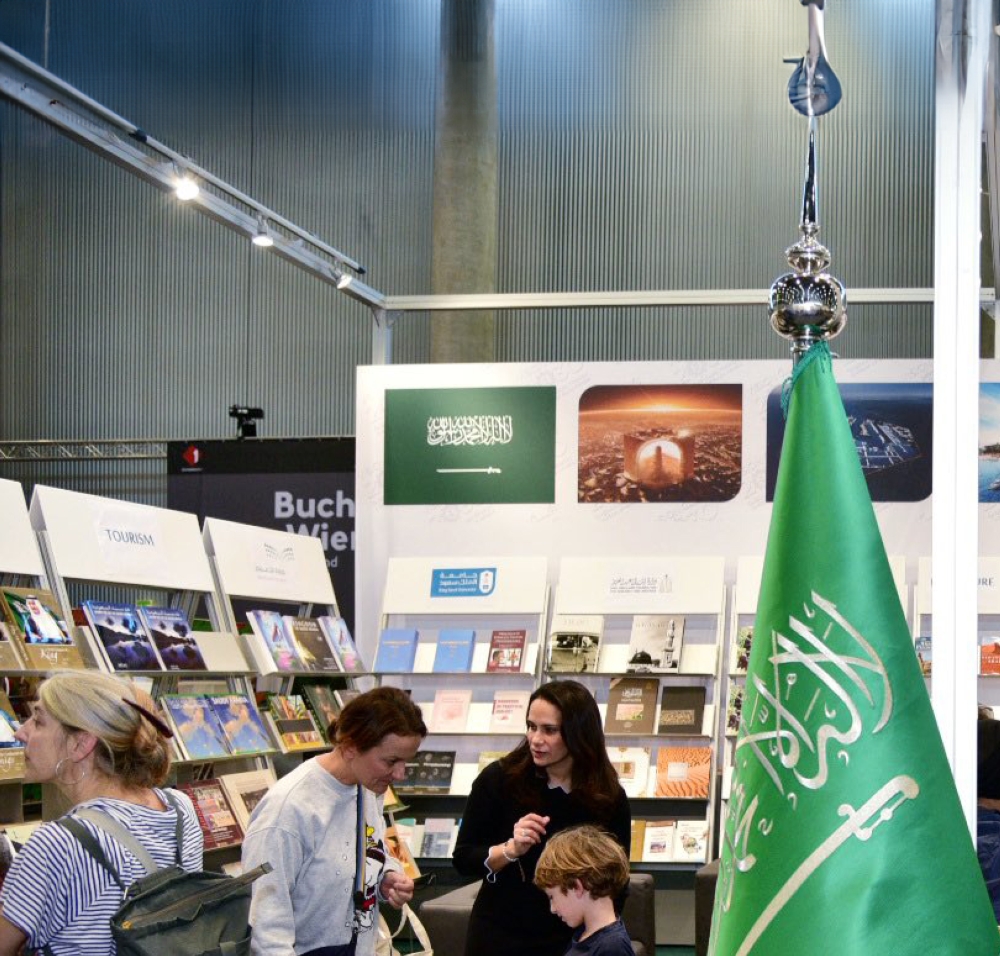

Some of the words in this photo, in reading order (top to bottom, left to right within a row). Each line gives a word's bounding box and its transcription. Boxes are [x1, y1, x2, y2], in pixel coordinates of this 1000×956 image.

[274, 490, 356, 519] Buch
[105, 529, 155, 546] TOURISM
[286, 522, 356, 551] ie
